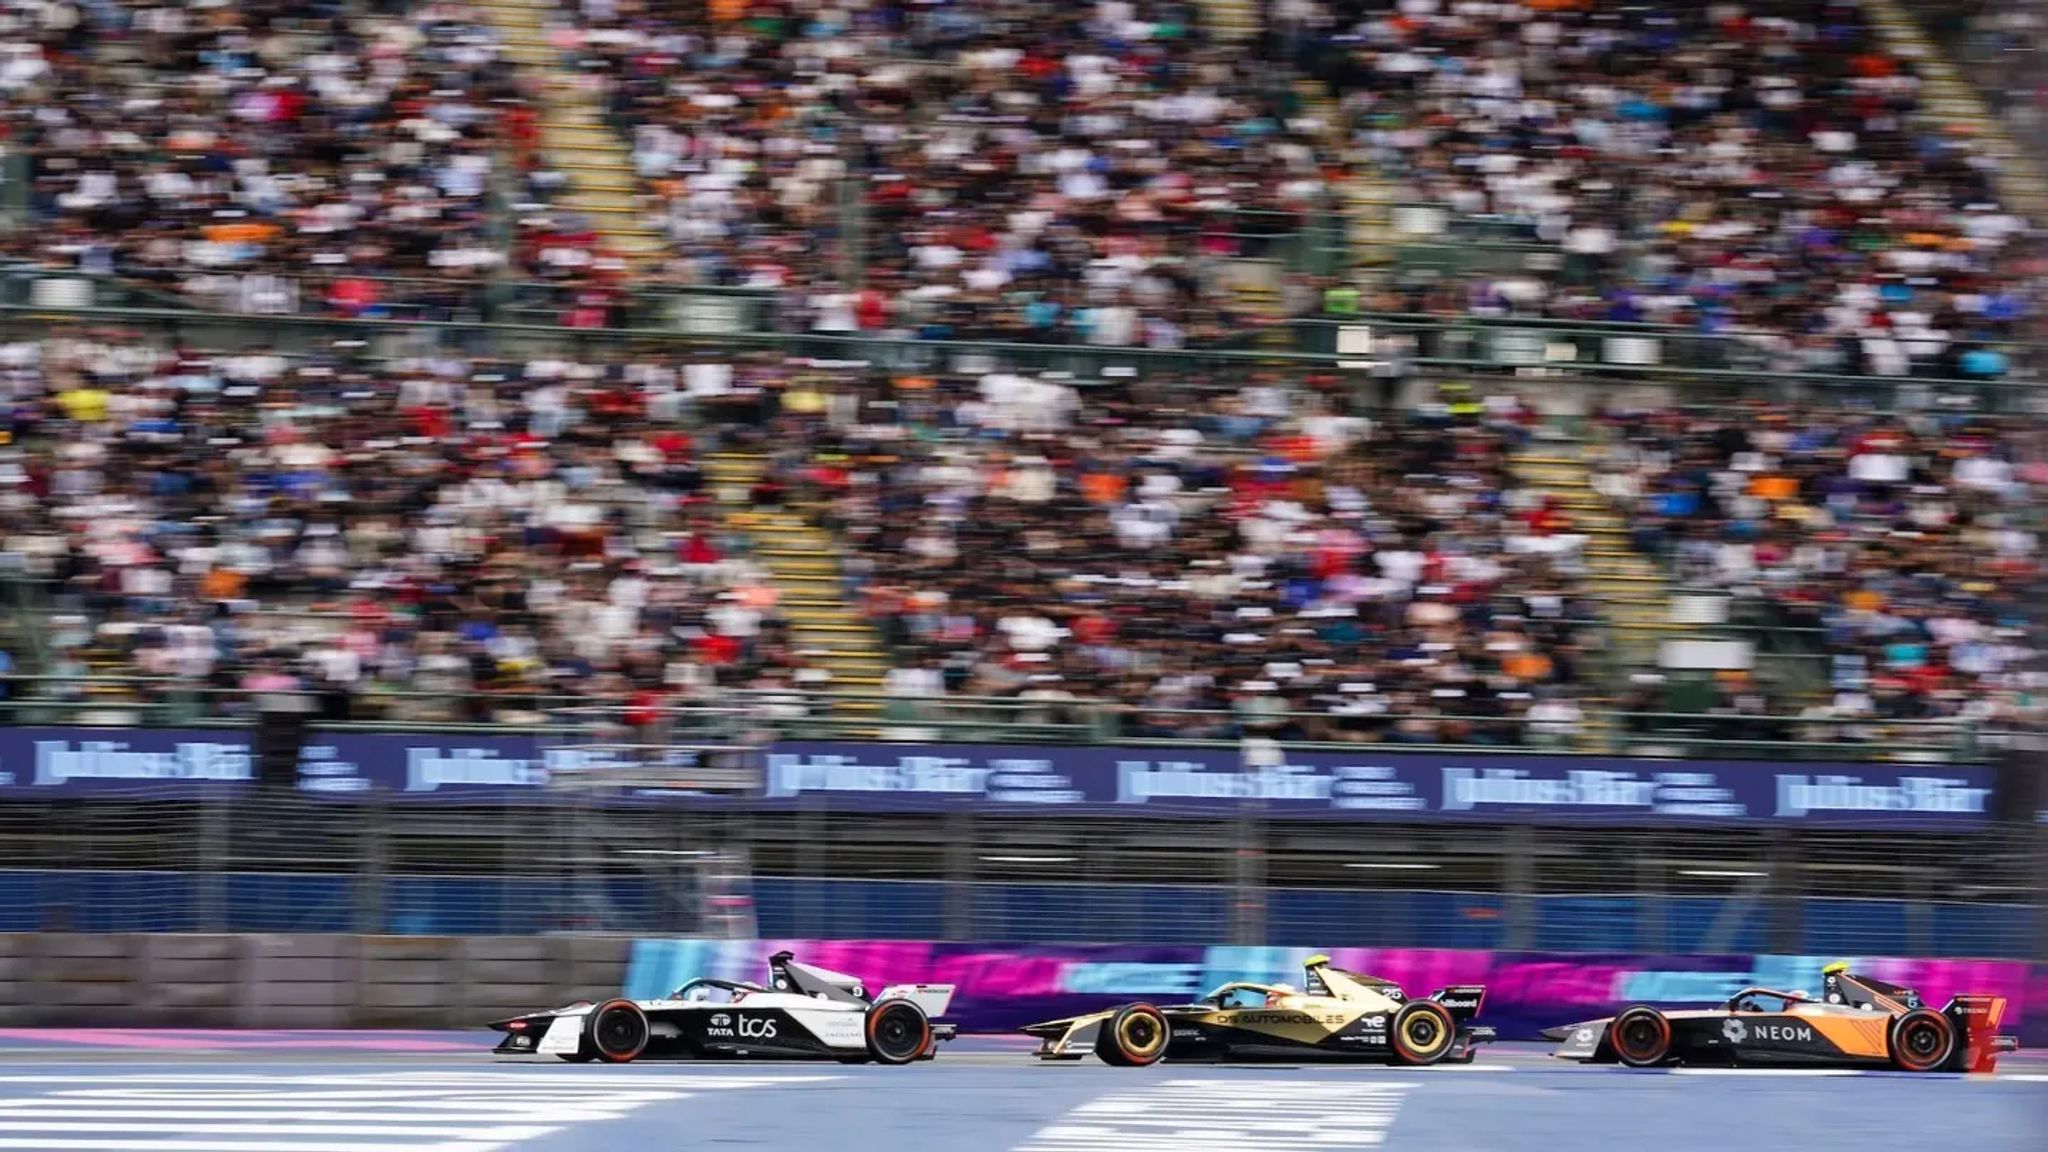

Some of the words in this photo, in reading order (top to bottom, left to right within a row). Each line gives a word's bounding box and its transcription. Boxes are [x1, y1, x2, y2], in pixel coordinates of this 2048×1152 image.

[1382, 987, 1402, 1000] 25
[738, 1013, 777, 1038] tcs
[1217, 1015, 1238, 1024] DS
[1241, 1015, 1345, 1024] AUTOMOBILES
[707, 1028, 735, 1037] TATA
[1754, 1025, 1812, 1042] NEOM
